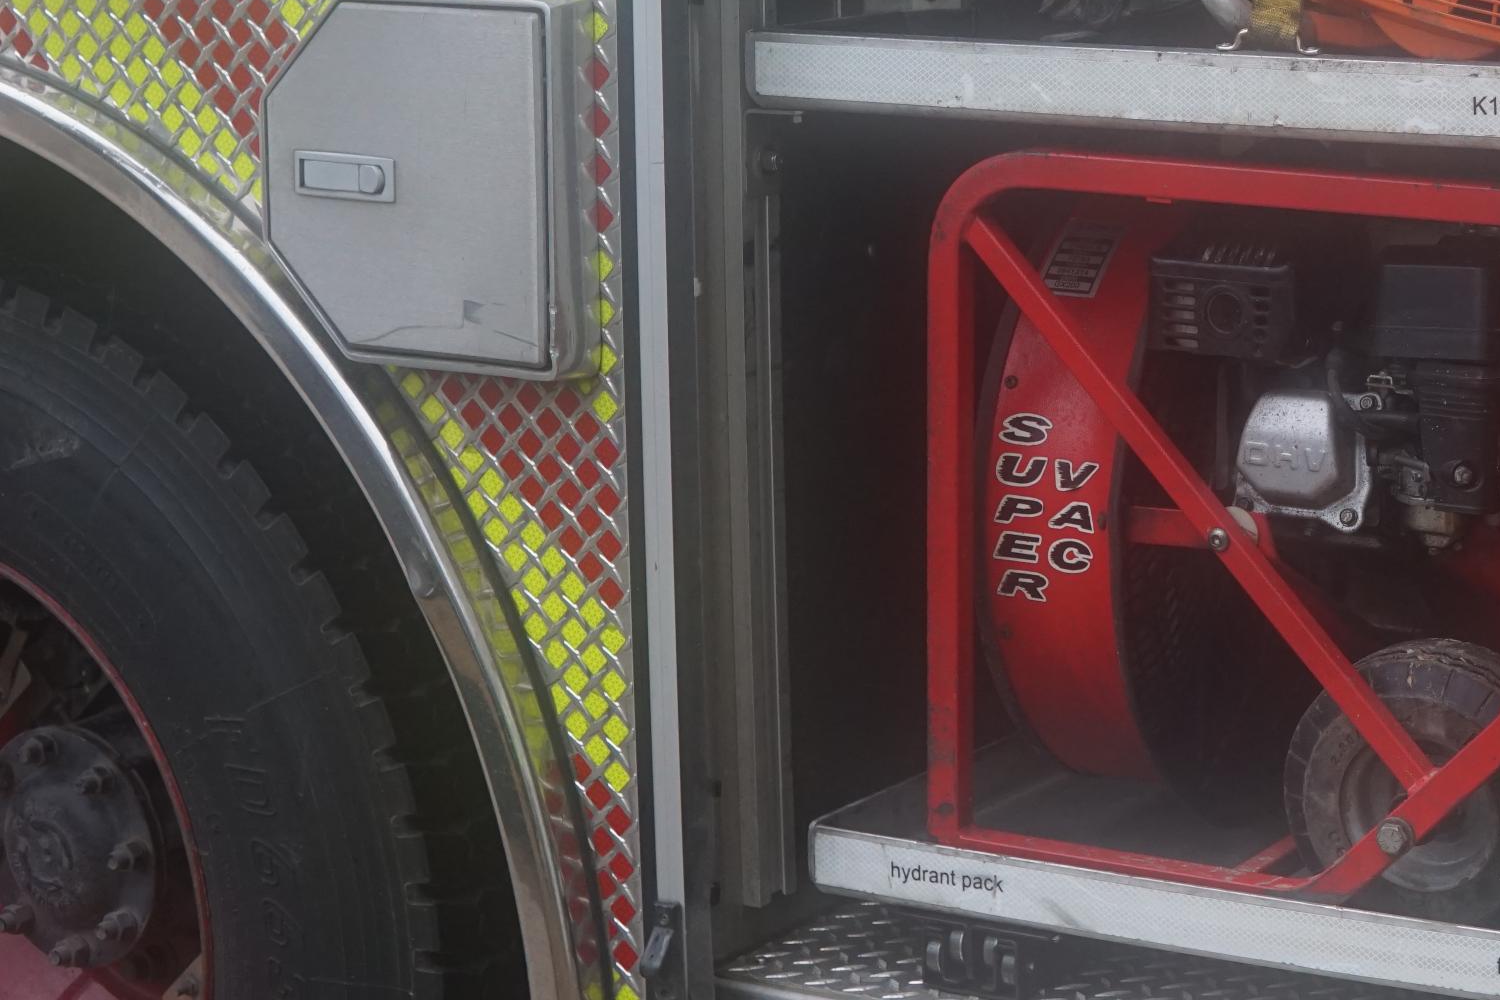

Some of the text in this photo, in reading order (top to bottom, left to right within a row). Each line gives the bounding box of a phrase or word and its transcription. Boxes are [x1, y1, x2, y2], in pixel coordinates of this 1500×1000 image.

[993, 412, 1099, 603] SUPER VAC
[890, 861, 1004, 893] hydrant pack
